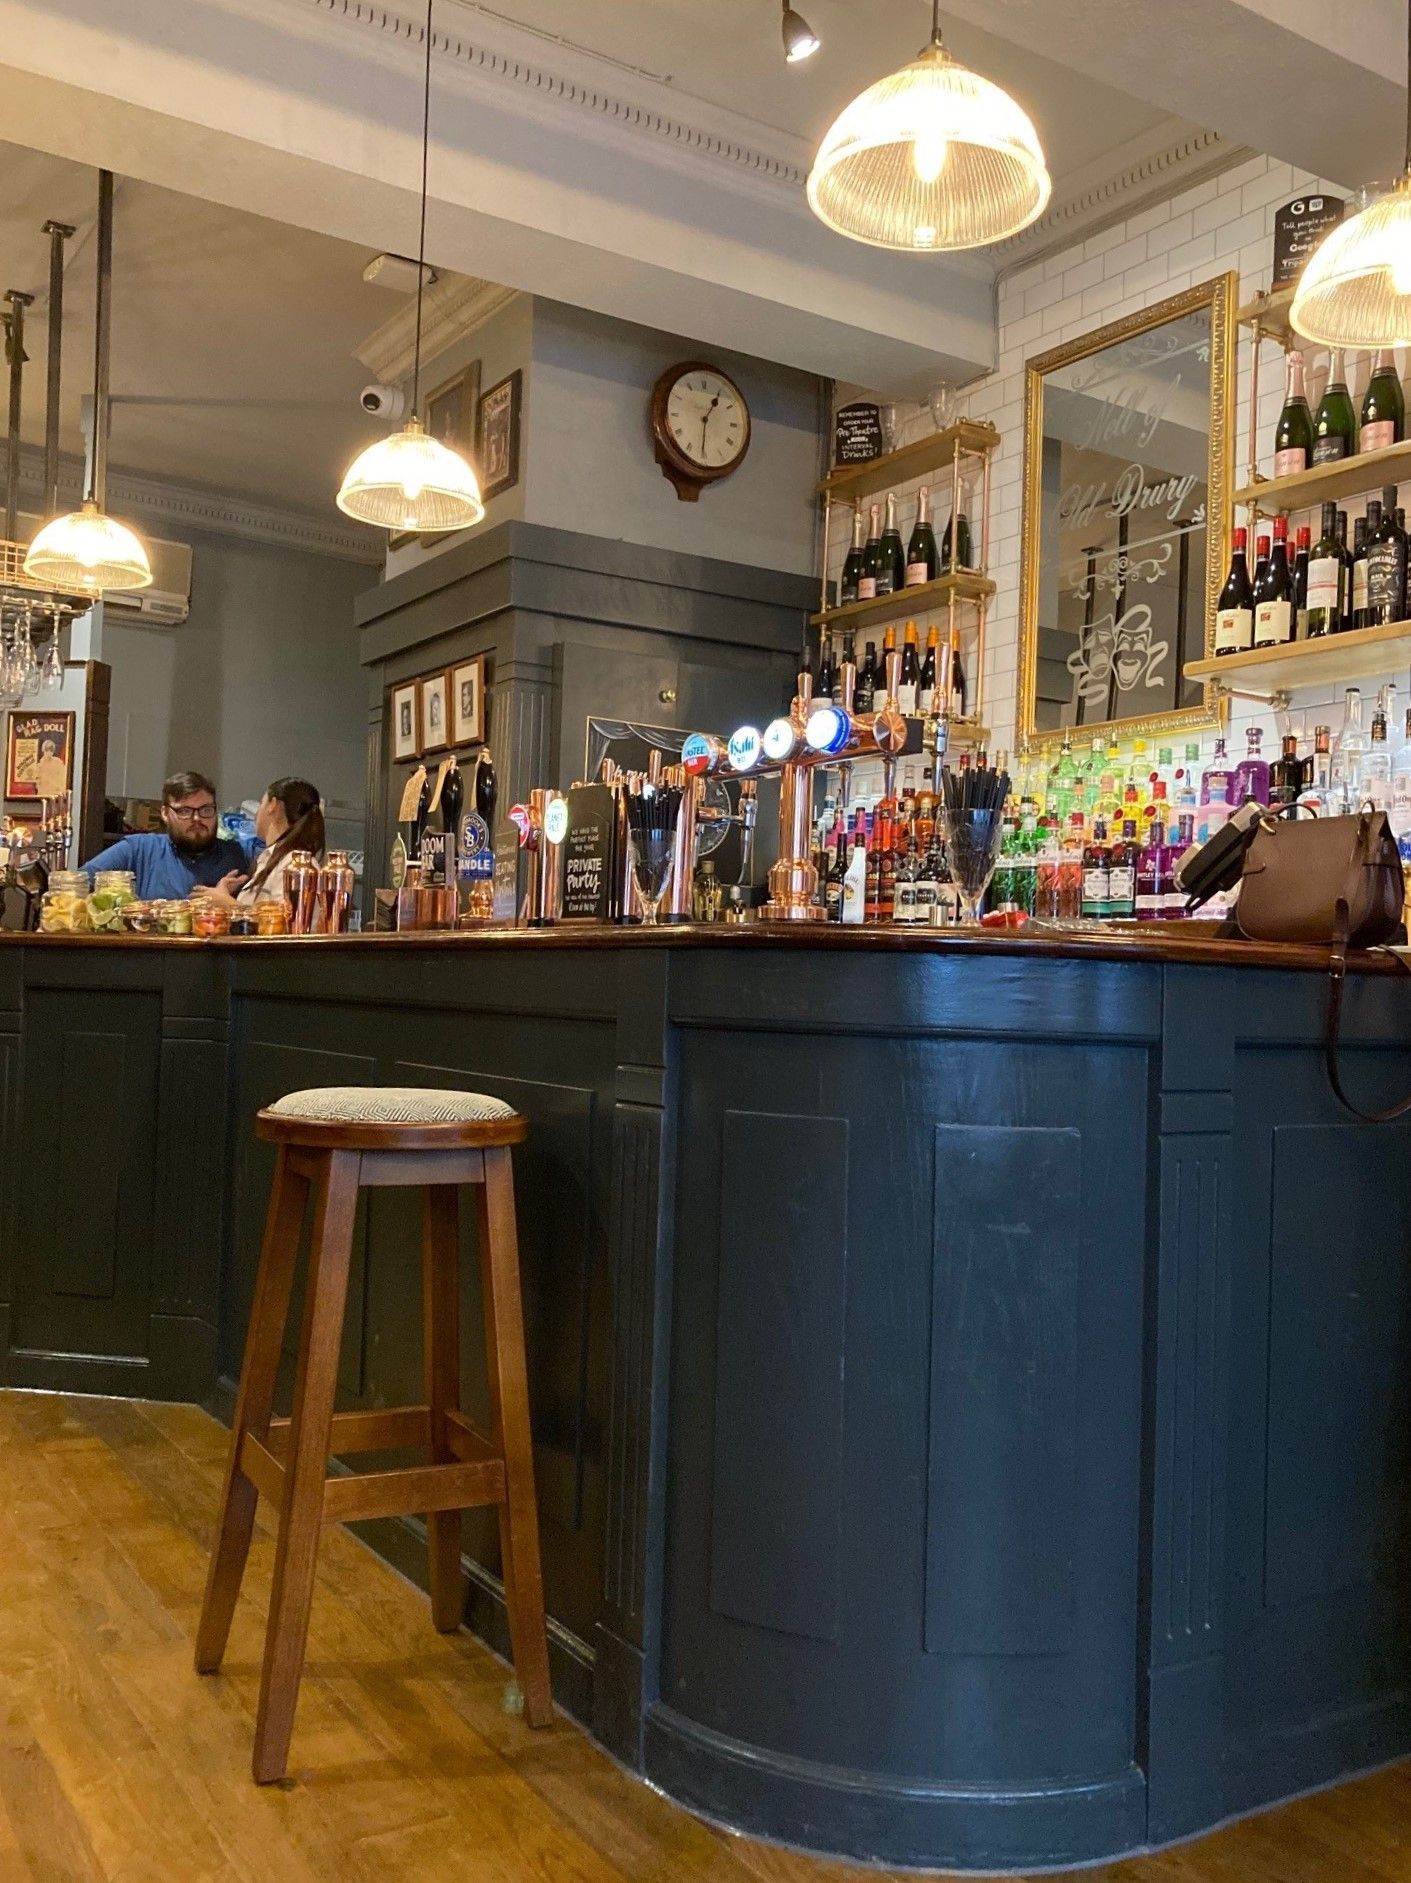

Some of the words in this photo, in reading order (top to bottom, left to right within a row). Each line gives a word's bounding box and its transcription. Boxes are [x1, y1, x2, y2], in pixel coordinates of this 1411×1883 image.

[1289, 241, 1320, 253] Googl
[1105, 463, 1200, 520] Drury
[16, 718, 38, 733] GLAD
[43, 723, 65, 732] DOLL
[458, 859, 491, 870] ANDLE
[567, 858, 602, 873] PRIVATE
